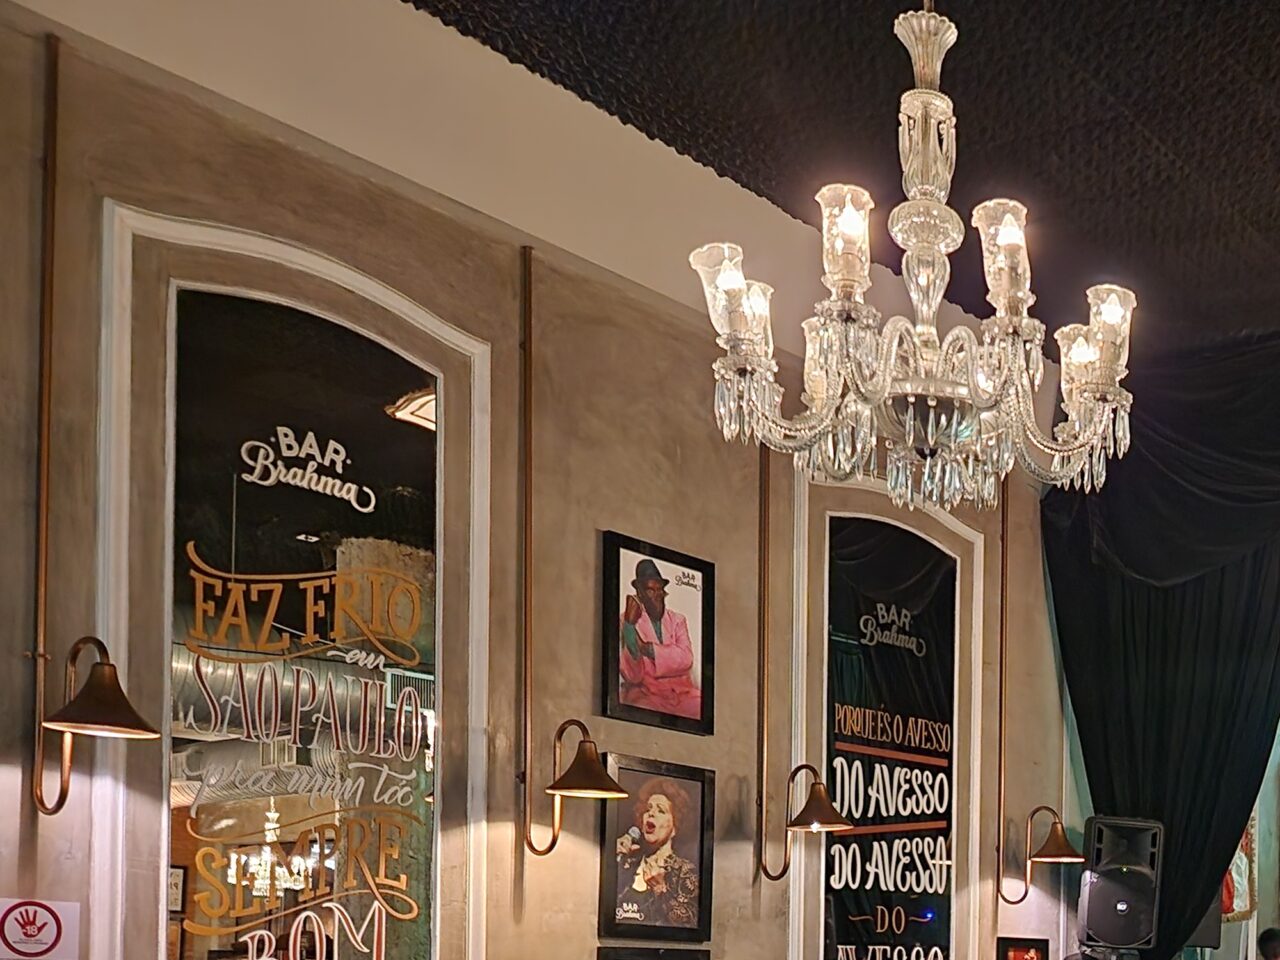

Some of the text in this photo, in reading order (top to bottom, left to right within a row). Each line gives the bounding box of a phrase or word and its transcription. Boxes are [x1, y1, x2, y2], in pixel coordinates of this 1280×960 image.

[276, 426, 347, 474] BAR
[240, 440, 376, 513] Brahma
[682, 571, 695, 582] BAR
[190, 568, 422, 666] FAZ FRIO
[859, 615, 926, 657] Brahma
[876, 603, 911, 631] BAR
[289, 665, 422, 762] PAULO
[834, 702, 876, 740] PORQUE
[893, 714, 903, 744] O
[904, 717, 951, 753] AVESSO
[832, 756, 949, 819] DO AVESSO
[194, 817, 419, 920] SEMPRE
[829, 836, 948, 894] DO AVESSO
[623, 902, 638, 912] BAR
[876, 905, 906, 934] DO
